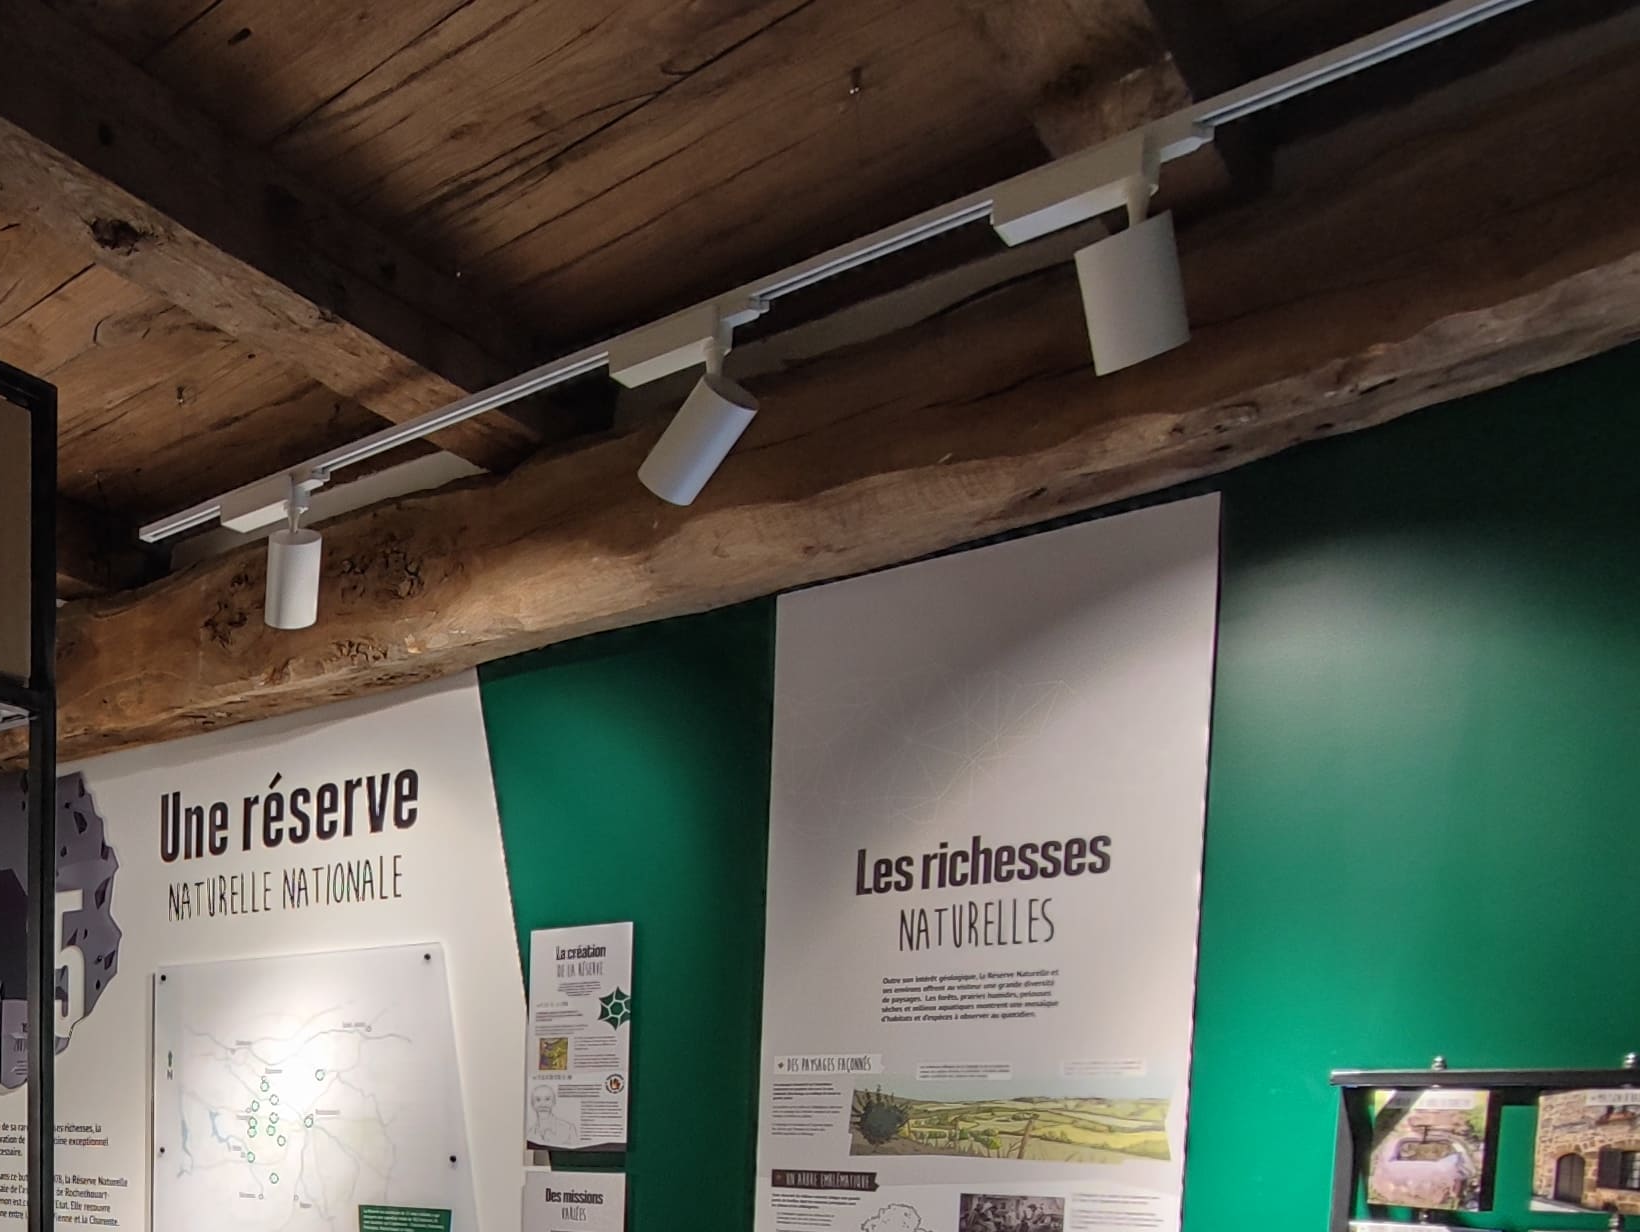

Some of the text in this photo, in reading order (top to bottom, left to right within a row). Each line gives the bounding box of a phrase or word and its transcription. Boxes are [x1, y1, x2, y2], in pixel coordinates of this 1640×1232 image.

[160, 768, 420, 863] Une réserve
[168, 854, 404, 922] NATURELLE NATIONALE
[855, 835, 1112, 896] Les richesses
[556, 944, 606, 960] La création
[899, 898, 1055, 952] NATURELLES
[787, 1058, 799, 1072] DES
[802, 1057, 835, 1072] PAYSAGES
[545, 1187, 604, 1205] Des missions
